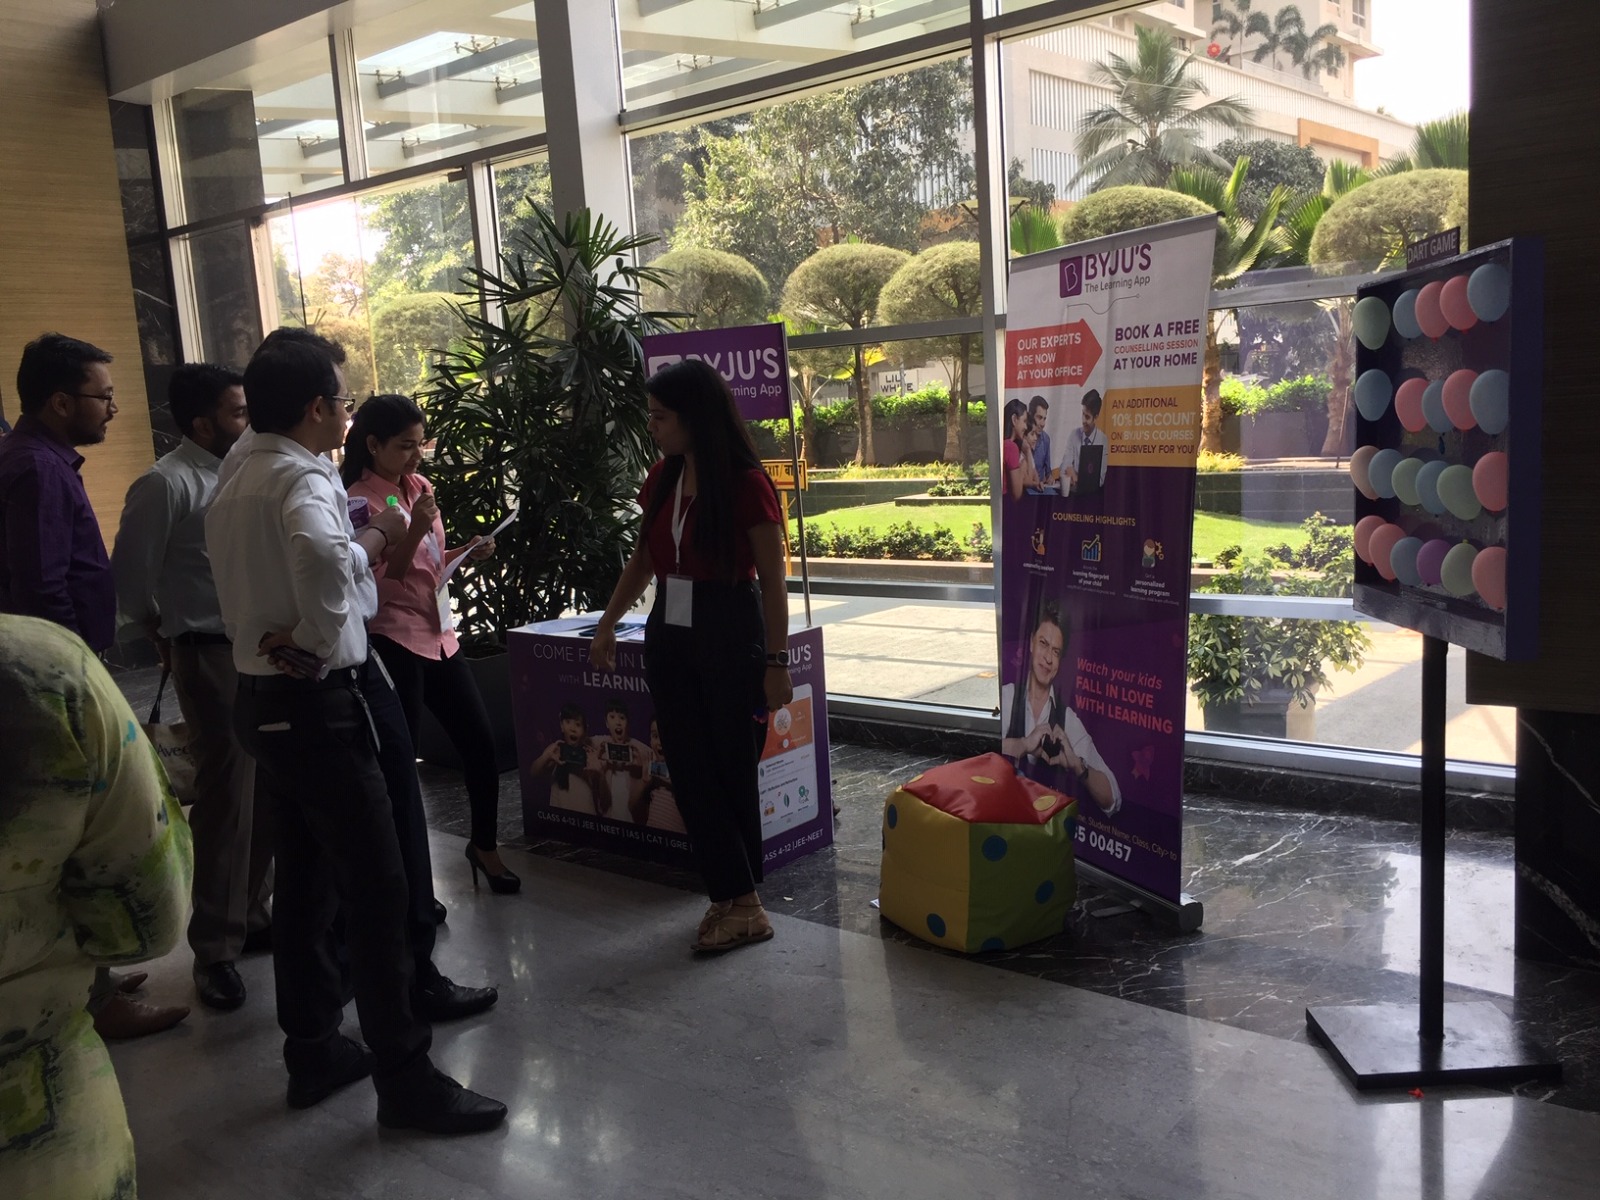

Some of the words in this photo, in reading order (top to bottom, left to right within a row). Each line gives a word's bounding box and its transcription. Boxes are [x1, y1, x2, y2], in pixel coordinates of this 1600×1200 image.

[1407, 241, 1429, 264] DART
[1430, 232, 1457, 256] GAME
[1085, 243, 1152, 281] BYJU'S
[1085, 282, 1099, 293] The
[1100, 276, 1133, 292] Learning
[1134, 274, 1151, 286] App
[1115, 324, 1150, 341] BOOK
[1153, 322, 1164, 338] A
[1167, 318, 1200, 336] FREE
[1017, 337, 1038, 351] OUR
[1040, 332, 1082, 348] EXPERTS
[1114, 342, 1165, 355] COUNSELLING
[1166, 338, 1199, 350] SESSION
[685, 347, 780, 382] YJU'S
[1017, 355, 1034, 366] ARE
[1035, 352, 1057, 364] NOW
[1113, 358, 1128, 371] AT
[1130, 355, 1161, 369] YOUR
[1164, 351, 1198, 367] HOME
[885, 373, 907, 383] LIL
[1017, 370, 1028, 381] AT
[1029, 368, 1053, 379] YOUR
[1054, 365, 1083, 378] OFFICE
[760, 383, 782, 397] App
[880, 382, 913, 393] WHE
[1112, 399, 1124, 409] AN
[1126, 397, 1178, 409] ADDITIONAL
[1111, 412, 1133, 427] 10%
[1135, 411, 1196, 426] DISCOUNT
[1110, 431, 1122, 441] ON
[1123, 430, 1150, 441] BYJU'S
[1152, 429, 1194, 441] COURSES
[1110, 444, 1156, 454] EXCLUSIVELY
[1158, 444, 1175, 453] FOR
[1052, 512, 1094, 524] COUNSELING
[1095, 514, 1136, 527] HIGHLIGHTS
[533, 643, 574, 662] COME
[620, 652, 635, 668] IN
[786, 643, 812, 666] JU'S
[559, 673, 580, 685] WITH
[583, 671, 651, 694] LEARNIN
[1077, 657, 1109, 677] Watch
[1110, 668, 1136, 683] your
[1137, 672, 1163, 690] kids
[1076, 675, 1103, 695] FALL
[1105, 683, 1119, 699] IN
[1121, 687, 1154, 709] LOVE
[1075, 694, 1105, 716] WITH
[1107, 703, 1174, 735] LEARNING
[537, 810, 561, 823] CLASS
[562, 816, 577, 827] 4-12
[582, 820, 596, 831] JEE
[600, 824, 621, 836] NEET
[626, 829, 641, 840] IAS
[646, 834, 664, 846] CAT
[670, 839, 689, 851] GRE
[1088, 816, 1111, 834] Student
[1170, 851, 1178, 862] to
[762, 850, 777, 864] ASS
[778, 843, 791, 855] 4-12
[1074, 825, 1086, 843] 5
[1089, 830, 1132, 863] 00457
